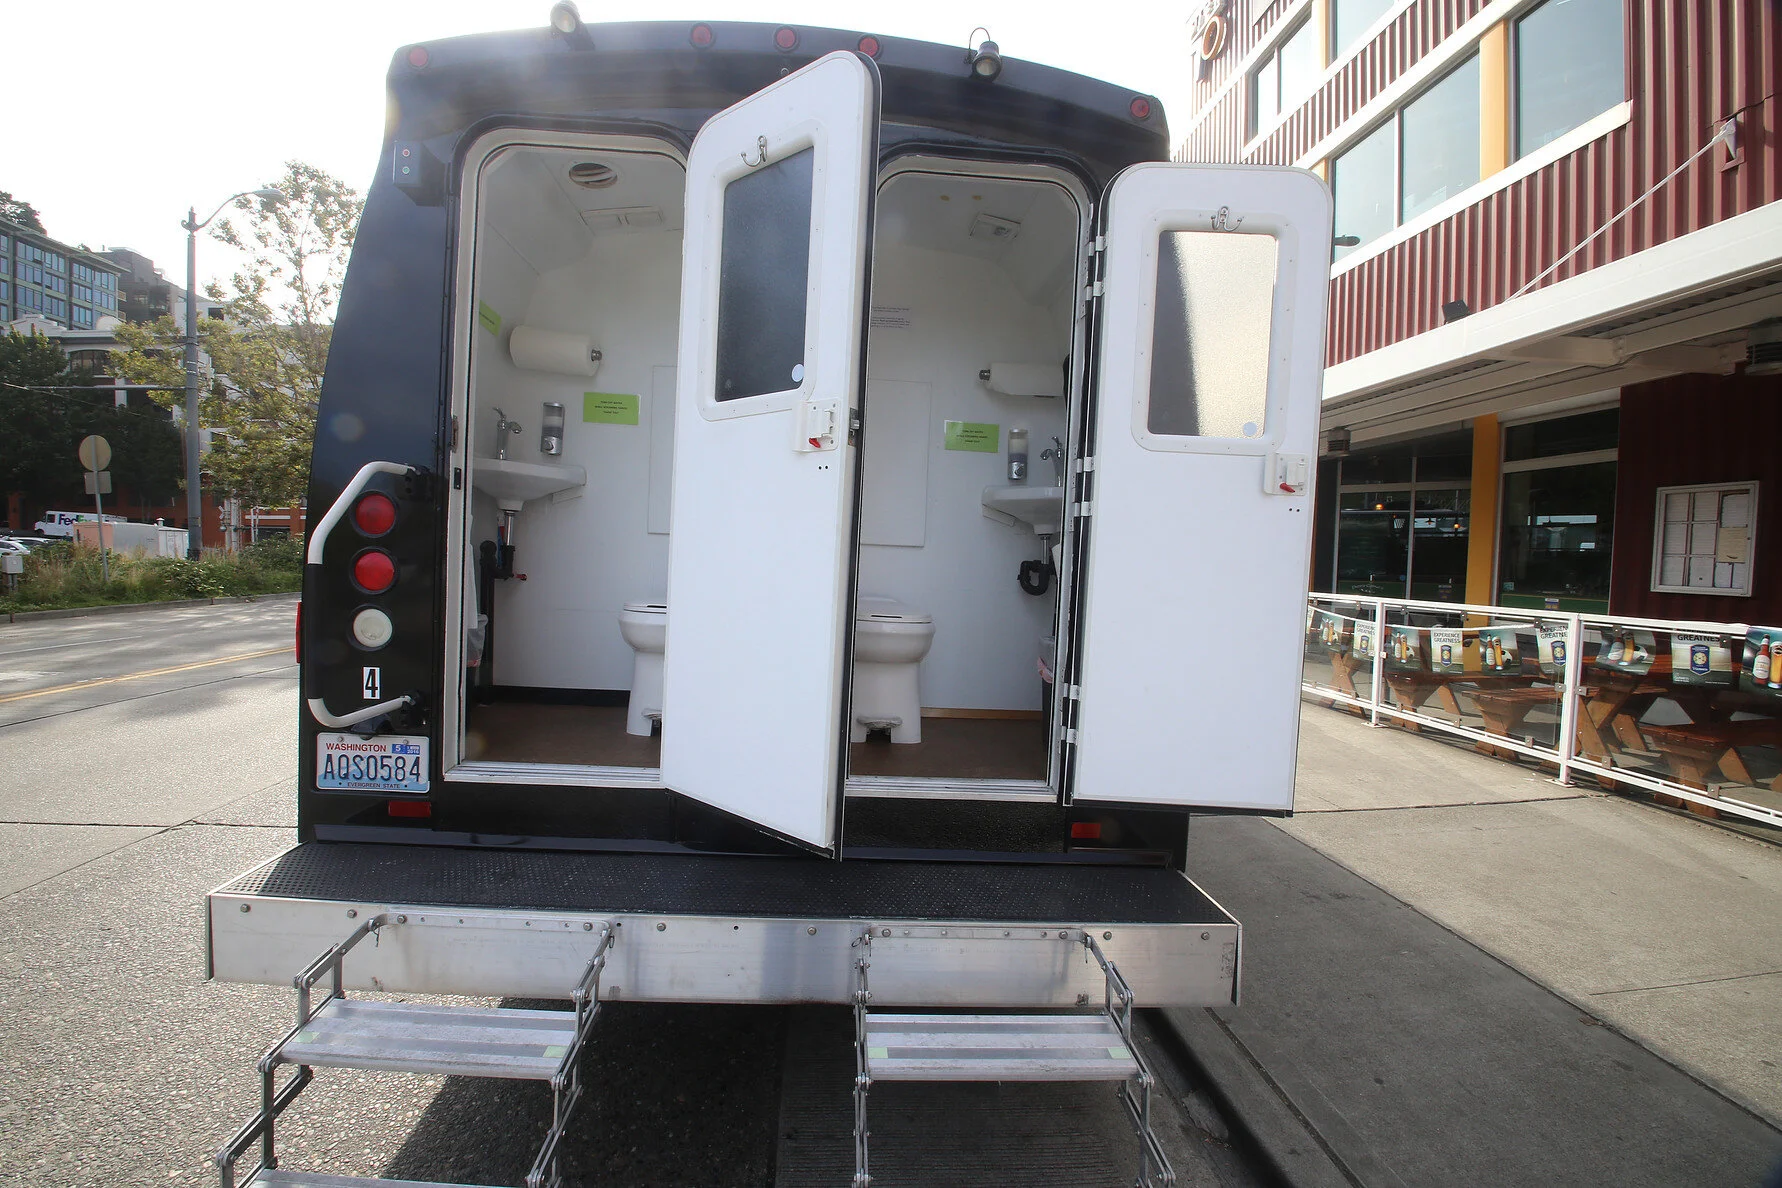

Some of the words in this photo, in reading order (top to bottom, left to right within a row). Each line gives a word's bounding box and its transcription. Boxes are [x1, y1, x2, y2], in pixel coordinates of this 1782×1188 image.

[58, 513, 92, 526] FedE
[1539, 625, 1569, 633] EXPERIEN
[1677, 634, 1720, 642] GREATNES
[365, 668, 379, 698] 4
[325, 742, 387, 752] WASHINGTON
[395, 744, 401, 752] 5
[323, 753, 421, 782] AQS0584
